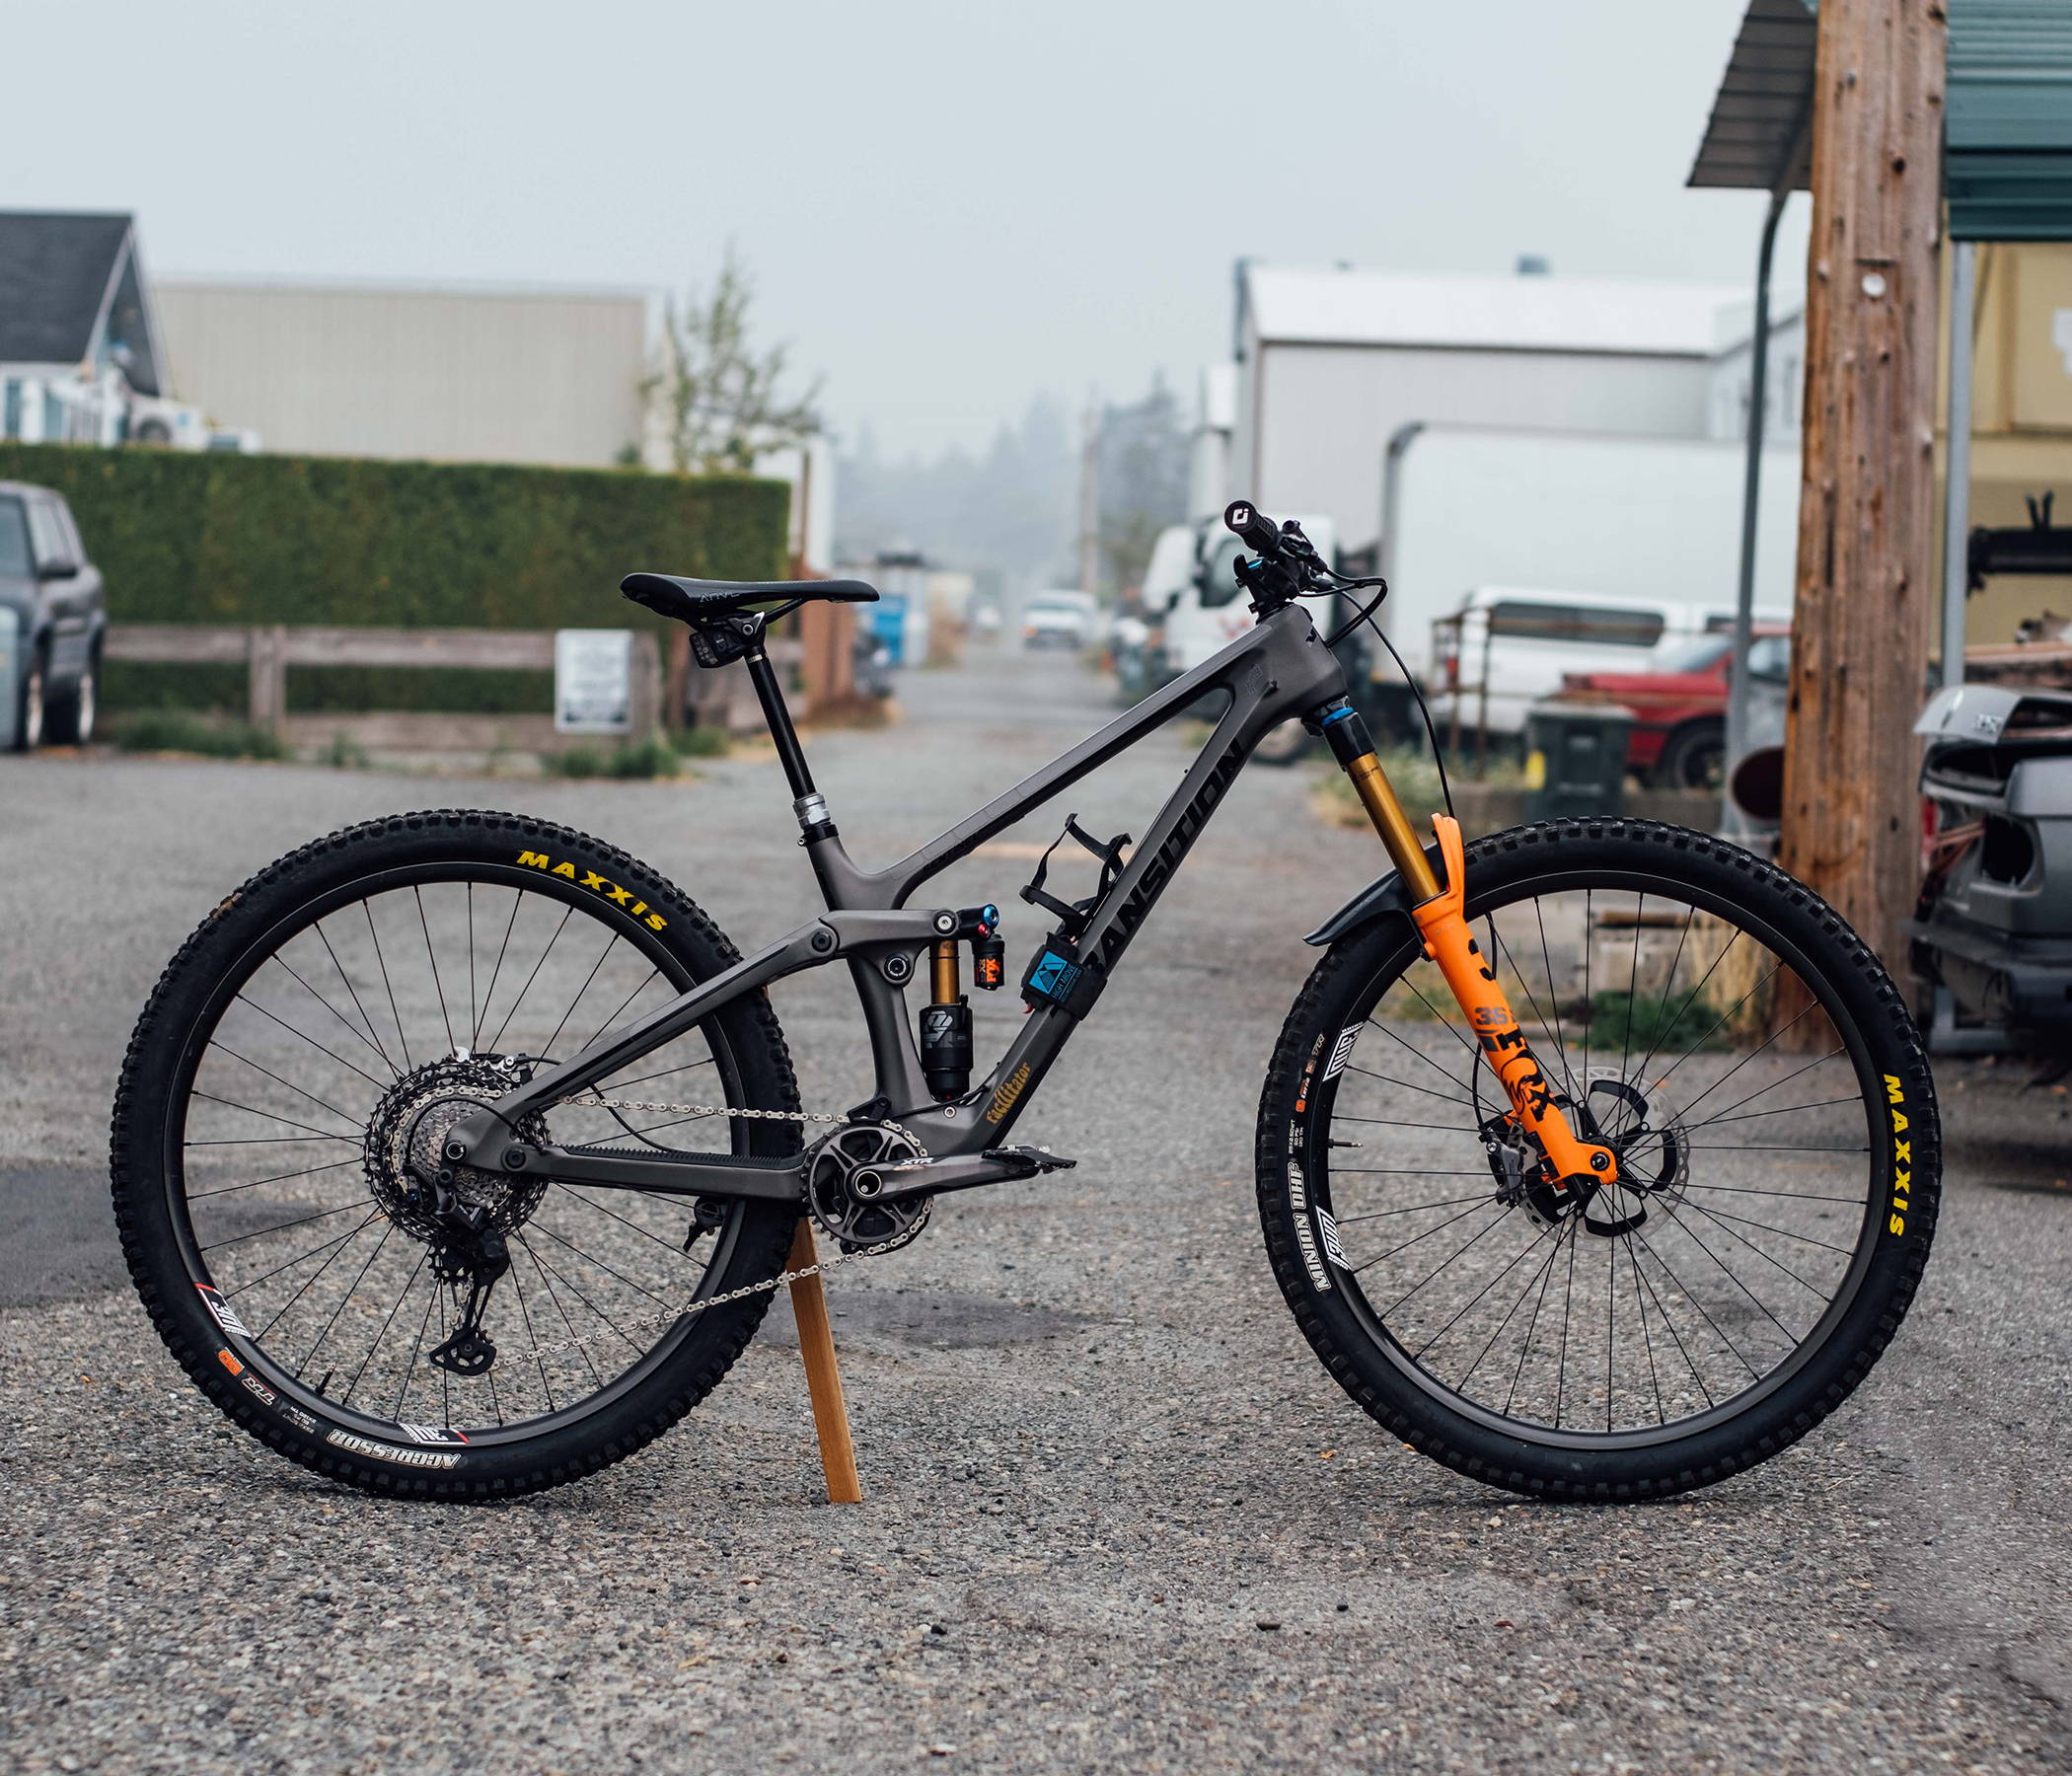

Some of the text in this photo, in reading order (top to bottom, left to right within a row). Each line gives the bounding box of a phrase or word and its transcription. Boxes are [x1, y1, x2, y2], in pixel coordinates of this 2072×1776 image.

[516, 851, 668, 931] MAXXIS
[1883, 1073, 1911, 1237] MAXXIS
[1288, 1161, 1332, 1293] MINION DHF
[242, 1376, 275, 1406] TR
[326, 1428, 462, 1470] AGGRESSOR
